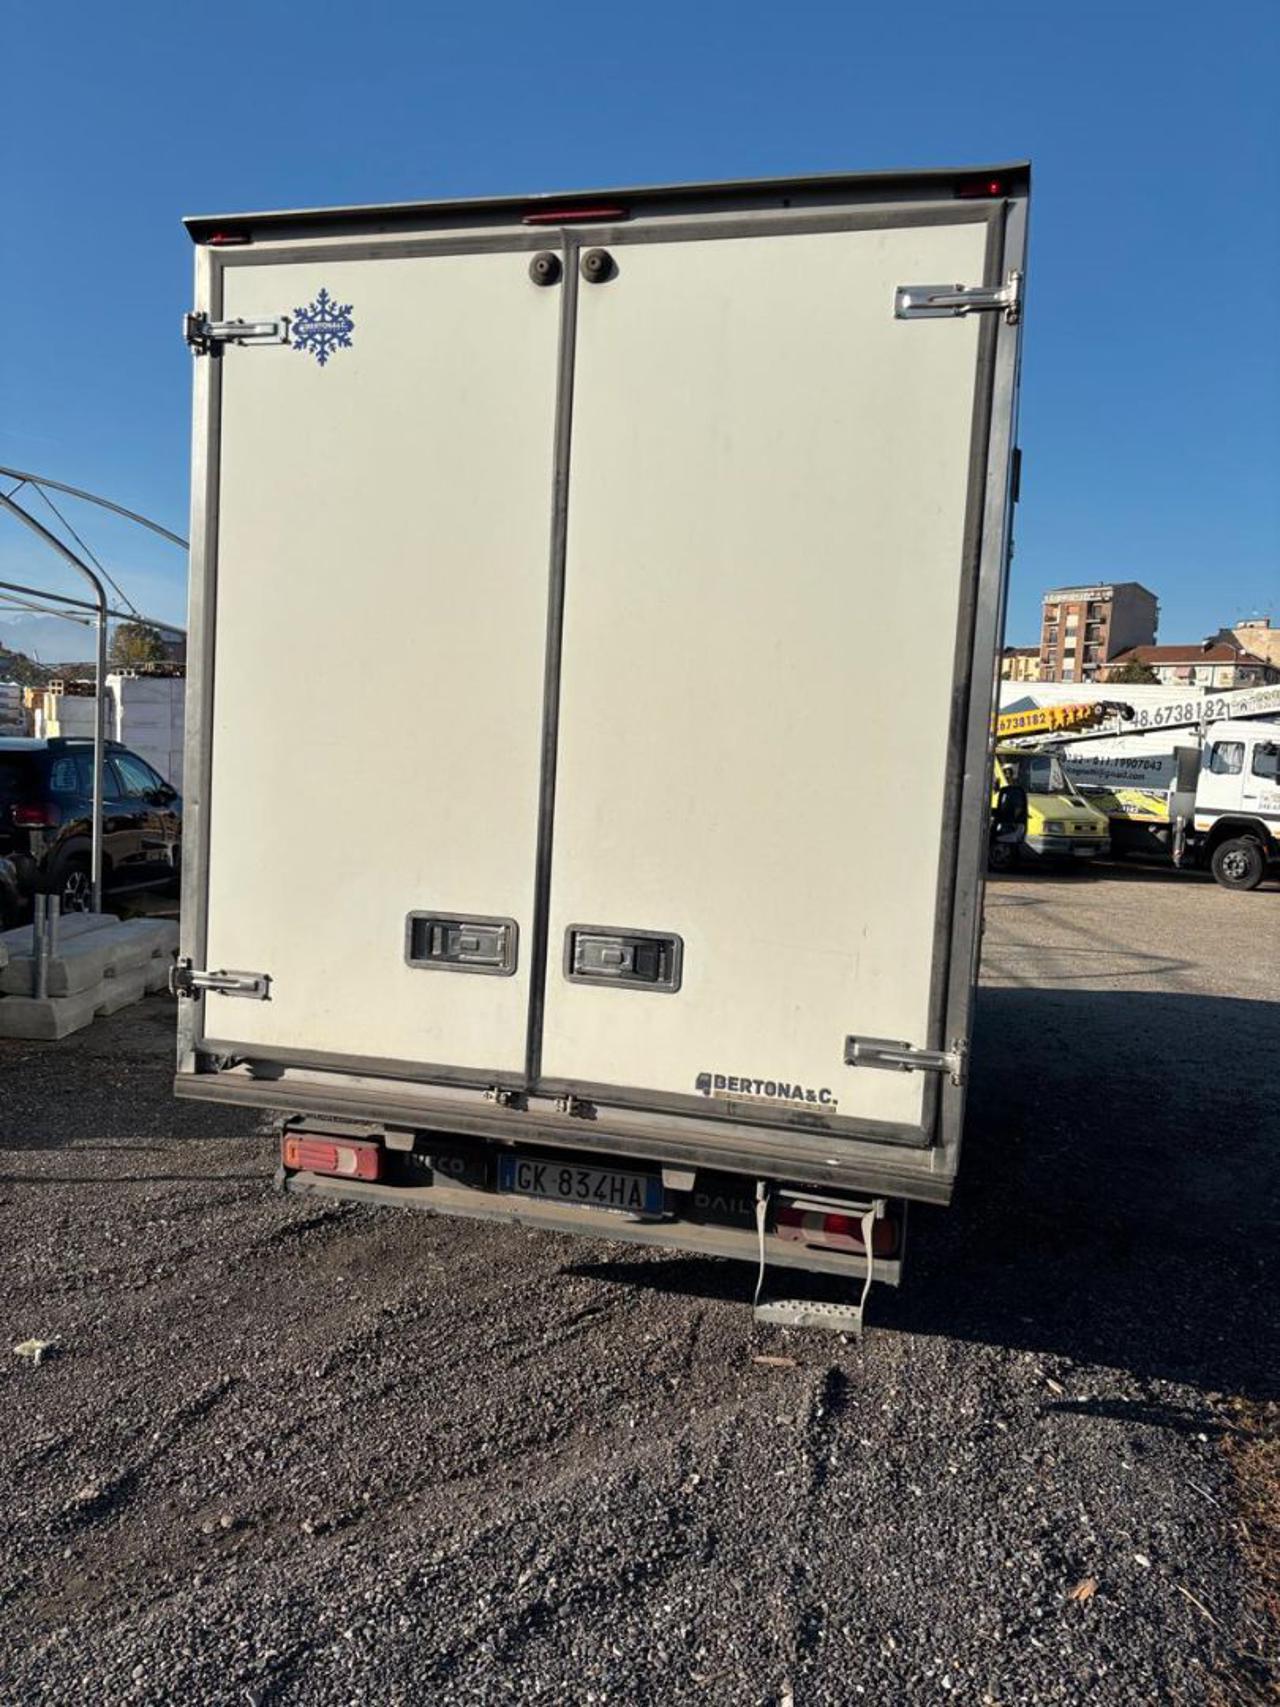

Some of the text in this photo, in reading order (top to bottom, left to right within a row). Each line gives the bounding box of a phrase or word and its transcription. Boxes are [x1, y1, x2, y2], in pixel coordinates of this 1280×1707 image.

[714, 1074, 838, 1105] BERTONA&C.
[518, 1162, 547, 1193] GK
[557, 1168, 643, 1208] 834HA
